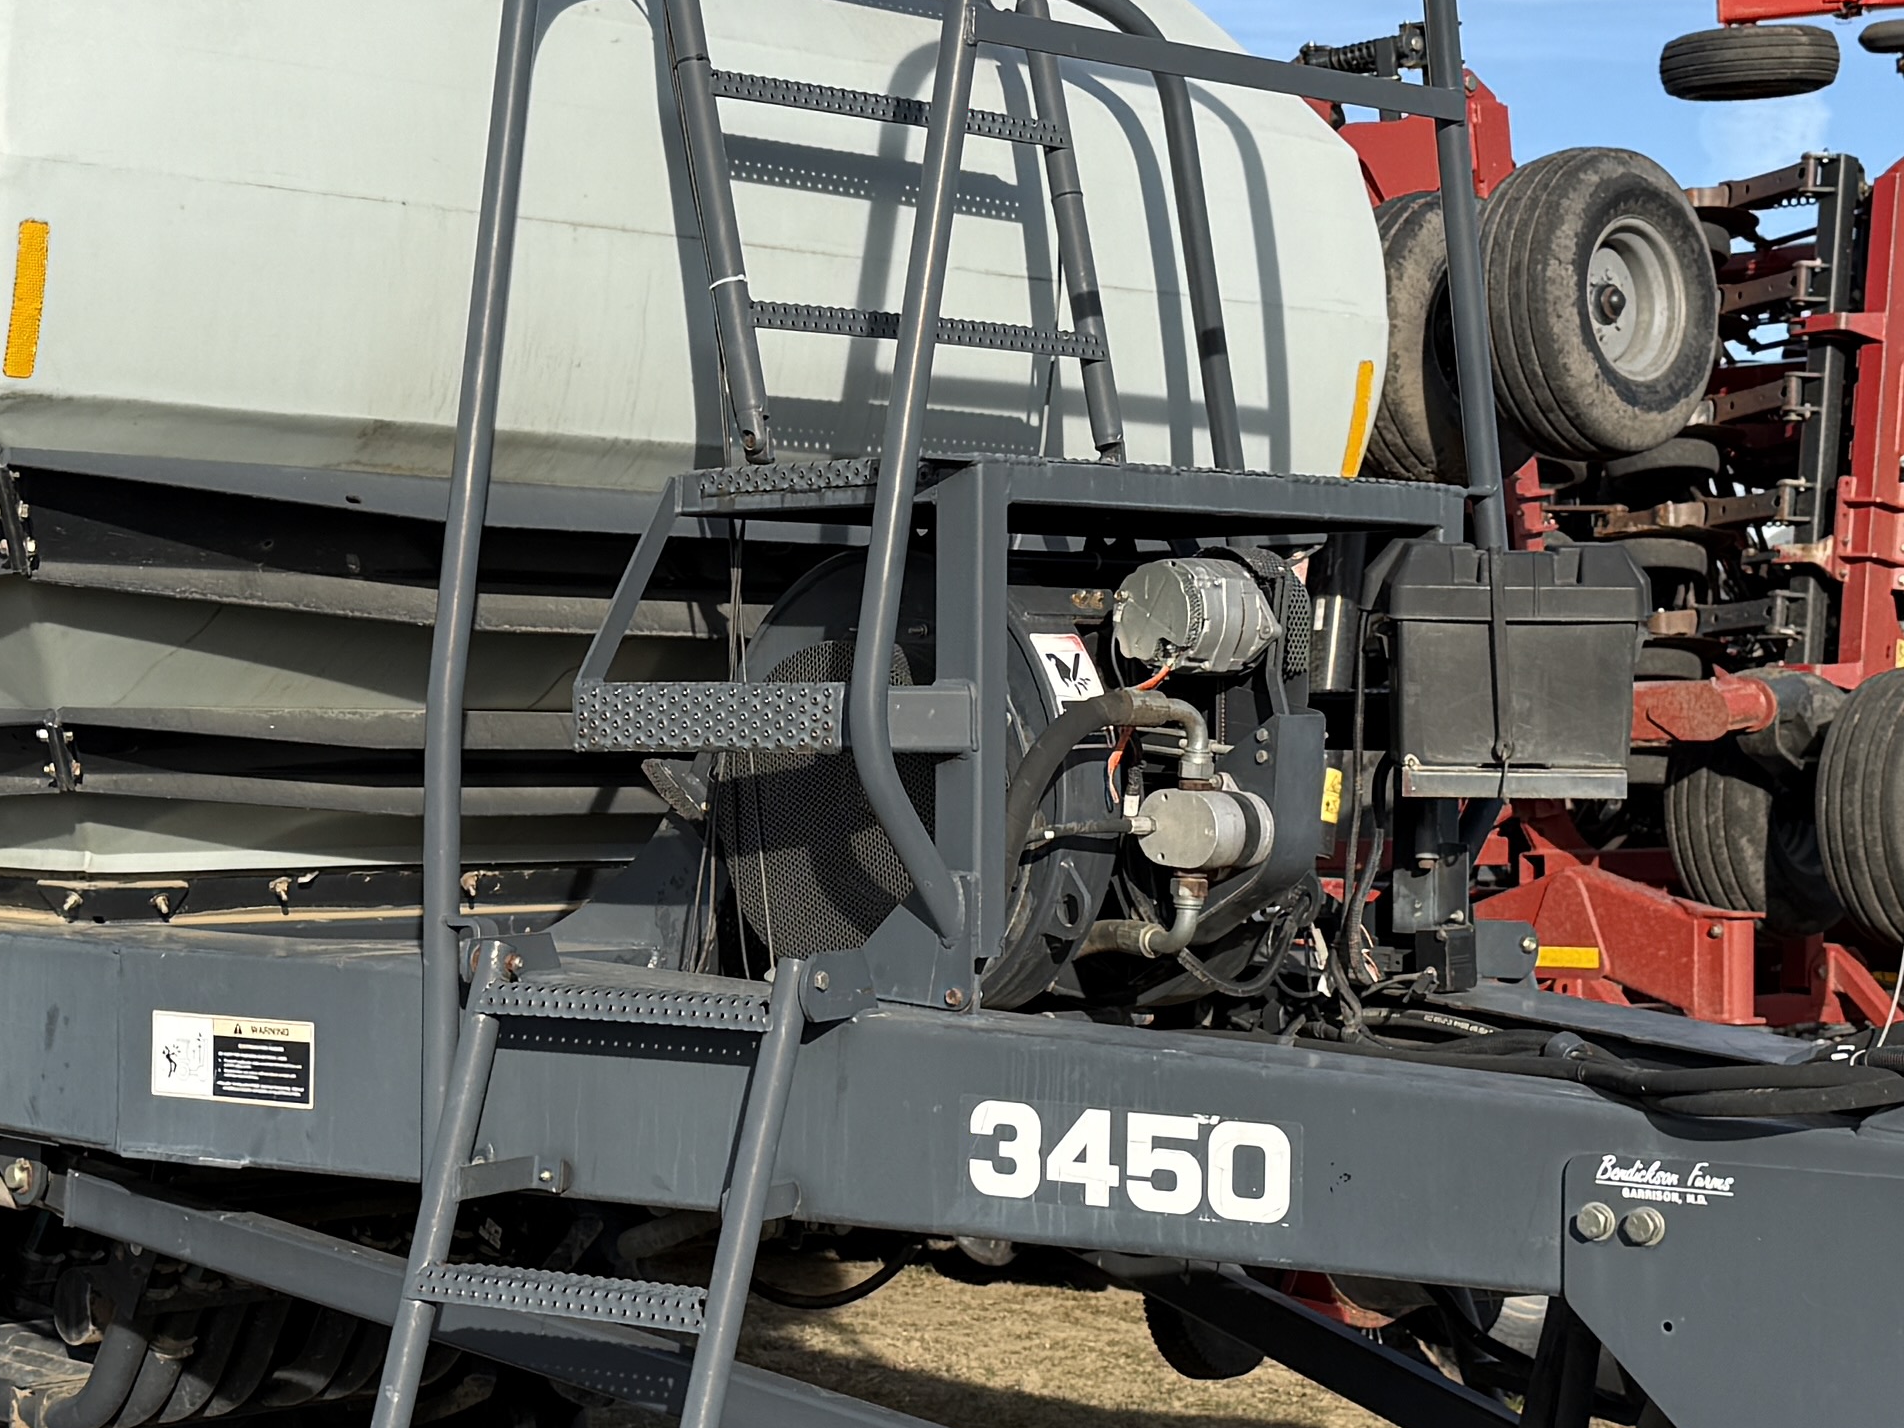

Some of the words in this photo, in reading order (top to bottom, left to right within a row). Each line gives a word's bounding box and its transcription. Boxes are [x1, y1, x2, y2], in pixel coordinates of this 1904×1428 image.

[967, 1099, 1293, 1226] 3450
[1595, 1154, 1680, 1186] Bendickson
[1687, 1162, 1735, 1192] Farms
[1621, 1187, 1683, 1205] GARRISON,
